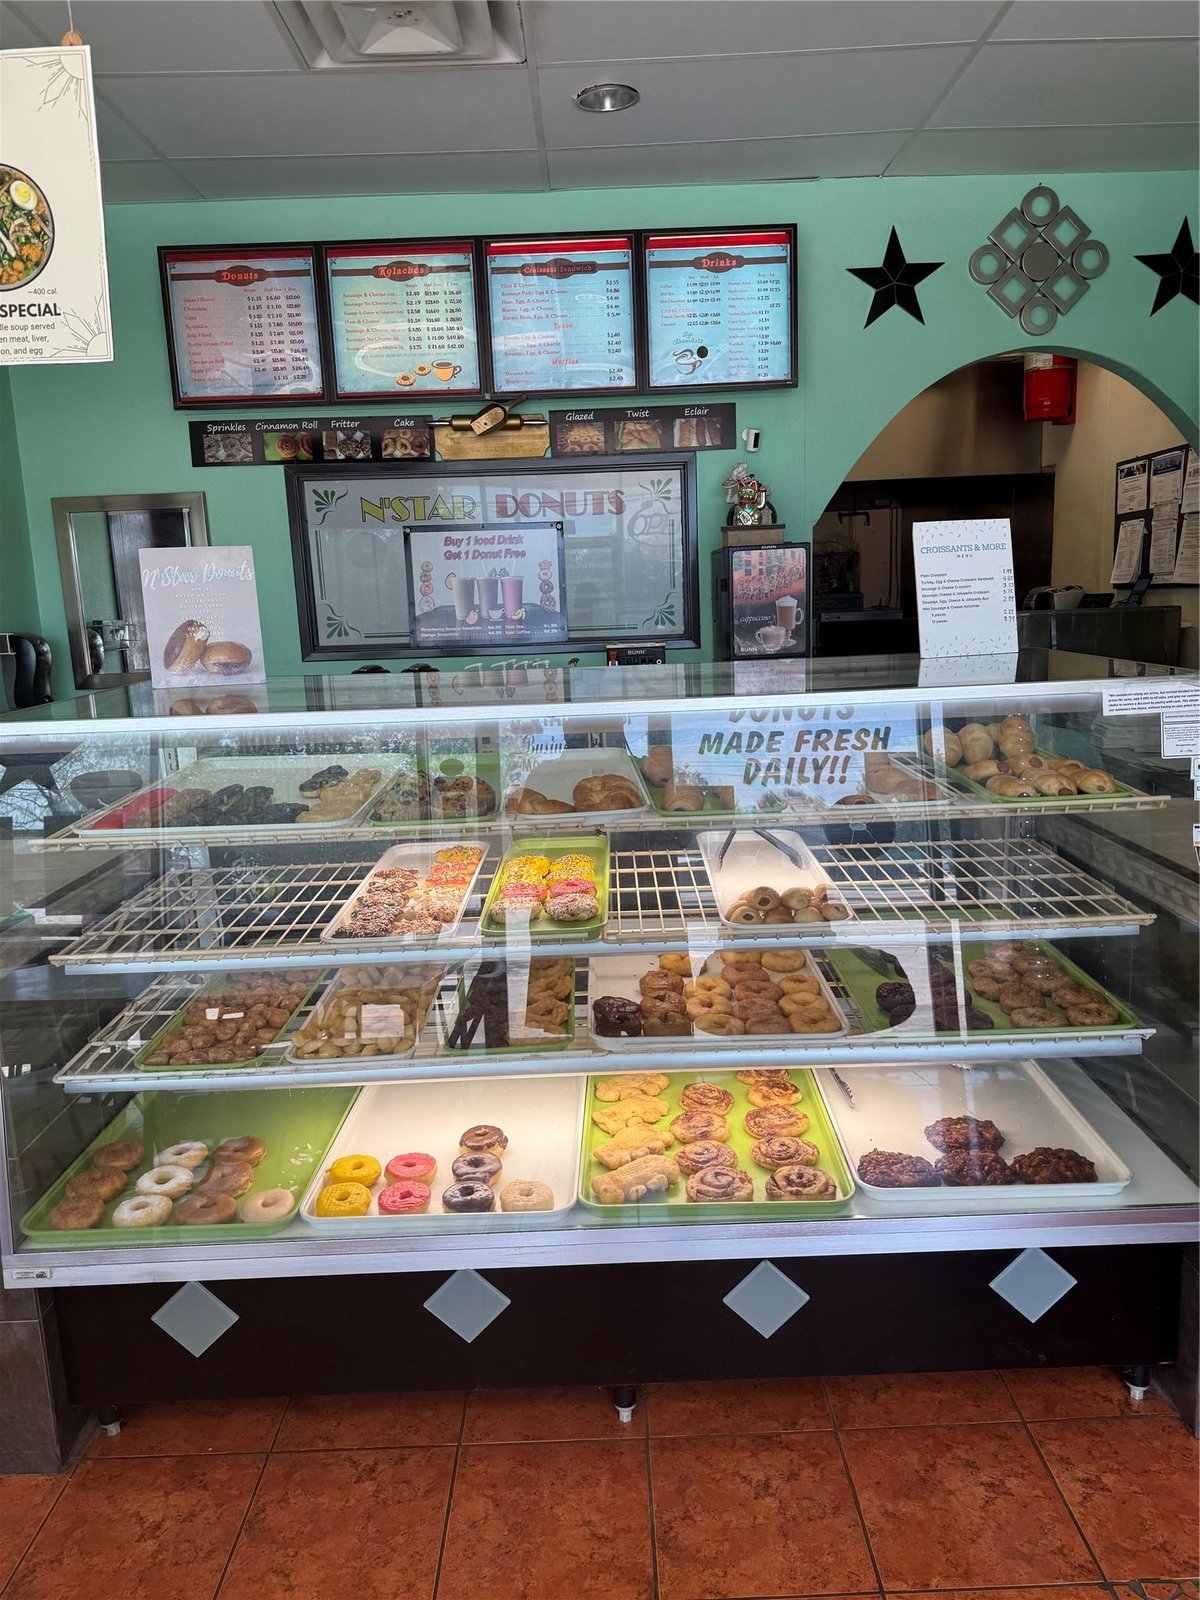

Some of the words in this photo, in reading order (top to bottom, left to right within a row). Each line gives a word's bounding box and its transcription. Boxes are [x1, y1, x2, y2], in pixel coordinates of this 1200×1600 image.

[559, 264, 592, 273] Sandwich
[701, 258, 737, 268] Drinks
[221, 270, 259, 282] Donuts
[378, 266, 426, 278] Kolaches
[0, 303, 62, 318] SPECIAL
[10, 324, 29, 332] soup
[30, 322, 56, 330] served
[565, 412, 594, 421] Glazed
[626, 409, 650, 418] Twist
[684, 407, 709, 416] Eclair
[206, 424, 246, 434] Sprinkles
[255, 422, 299, 430] Cinnamon
[302, 420, 318, 429] Roll
[331, 420, 360, 429] Fritter
[394, 418, 415, 427] Cake
[360, 494, 477, 523] N'STAR
[495, 489, 627, 519] DONUTS
[444, 536, 464, 548] Buy
[466, 536, 472, 546] 1
[473, 535, 496, 546] Iced
[497, 534, 524, 545] Drink
[920, 544, 973, 554] CROISSANTS
[982, 542, 1006, 551] MORE
[444, 550, 462, 560] Get
[464, 550, 470, 560] 1
[472, 549, 503, 560] Donut
[504, 548, 527, 559] Free
[202, 559, 256, 584] Donuts
[698, 730, 785, 756] MADE
[793, 726, 892, 754] FRESH
[742, 754, 852, 786] DAILY!!
